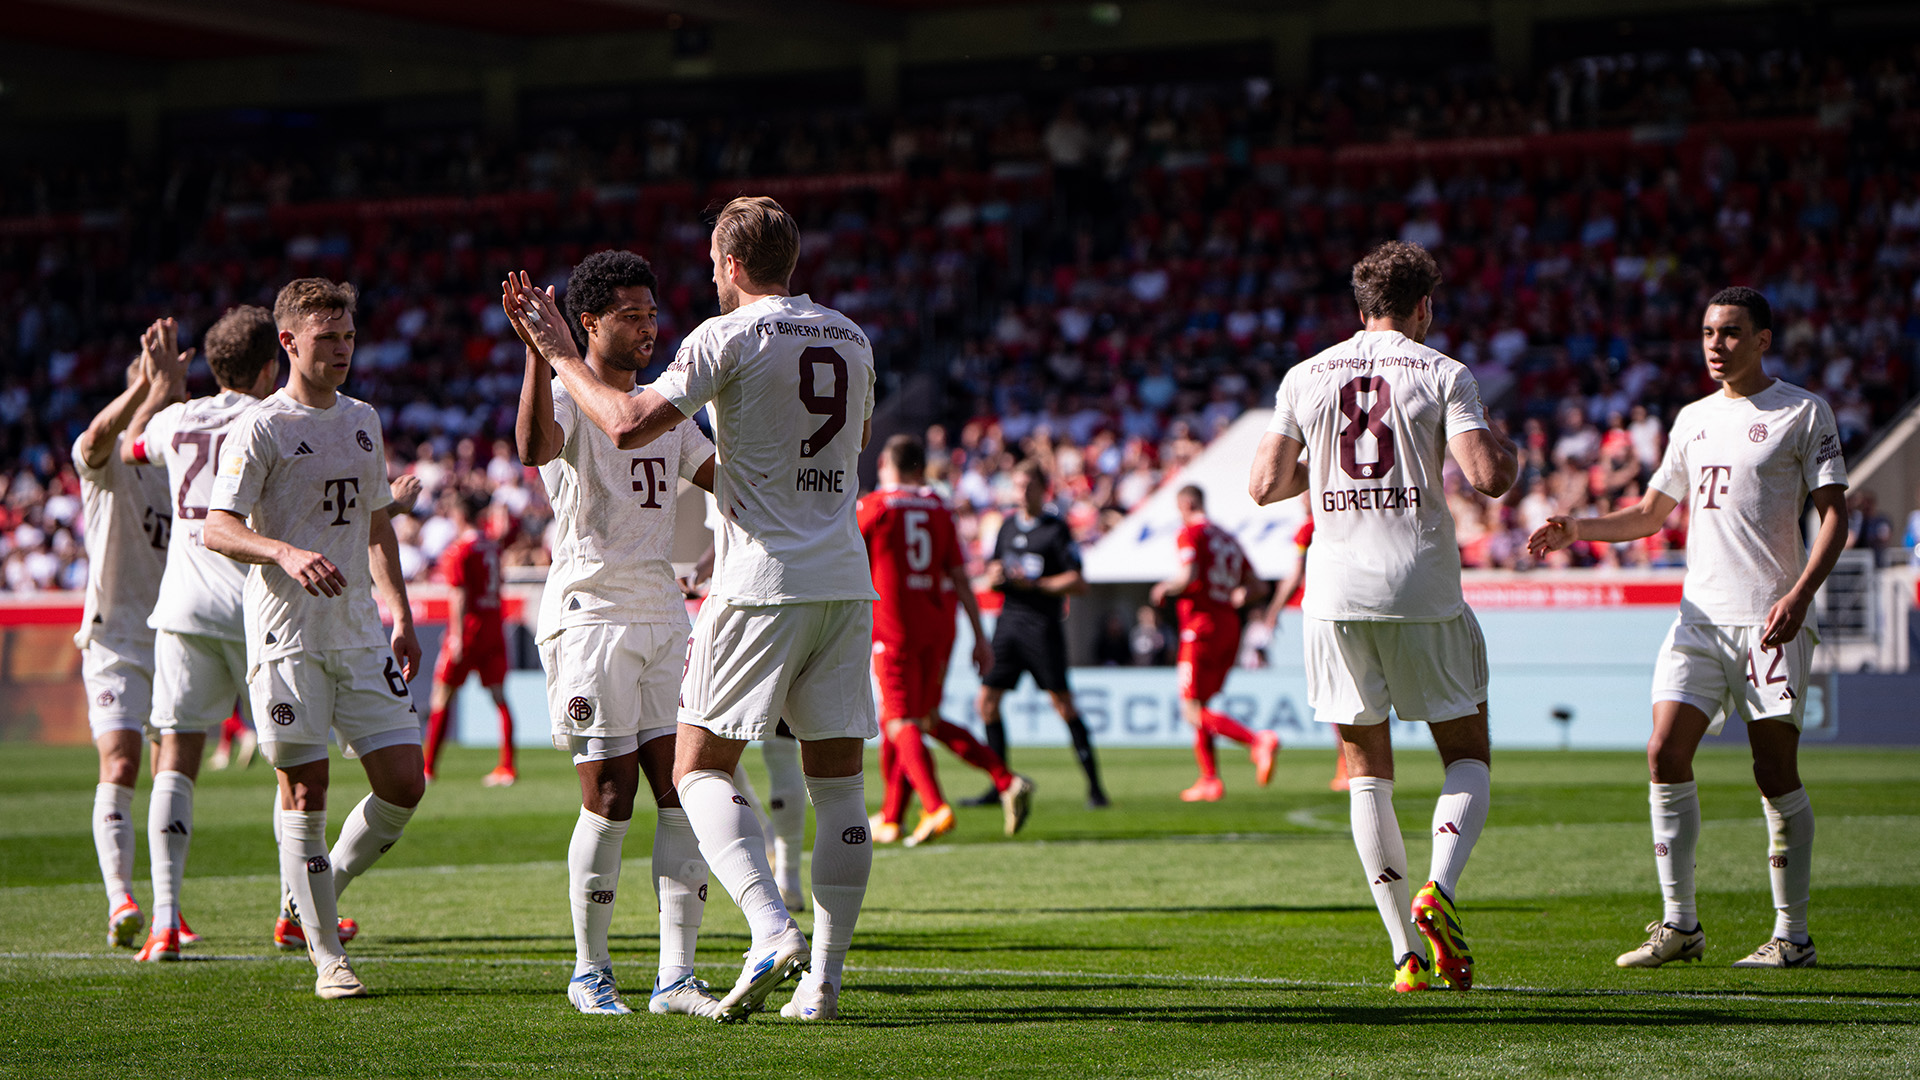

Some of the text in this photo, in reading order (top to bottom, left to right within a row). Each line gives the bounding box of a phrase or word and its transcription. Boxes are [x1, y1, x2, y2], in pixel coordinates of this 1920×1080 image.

[755, 321, 866, 349] FC BAYERN MÜNCHEN
[1310, 355, 1432, 375] FC BAYERN MÜNCHEN
[799, 346, 848, 458] 9
[1339, 374, 1395, 480] 8
[796, 468, 845, 493] KANE
[1322, 486, 1421, 512] GORETZKA
[904, 510, 932, 572] 5
[383, 656, 408, 697] 6
